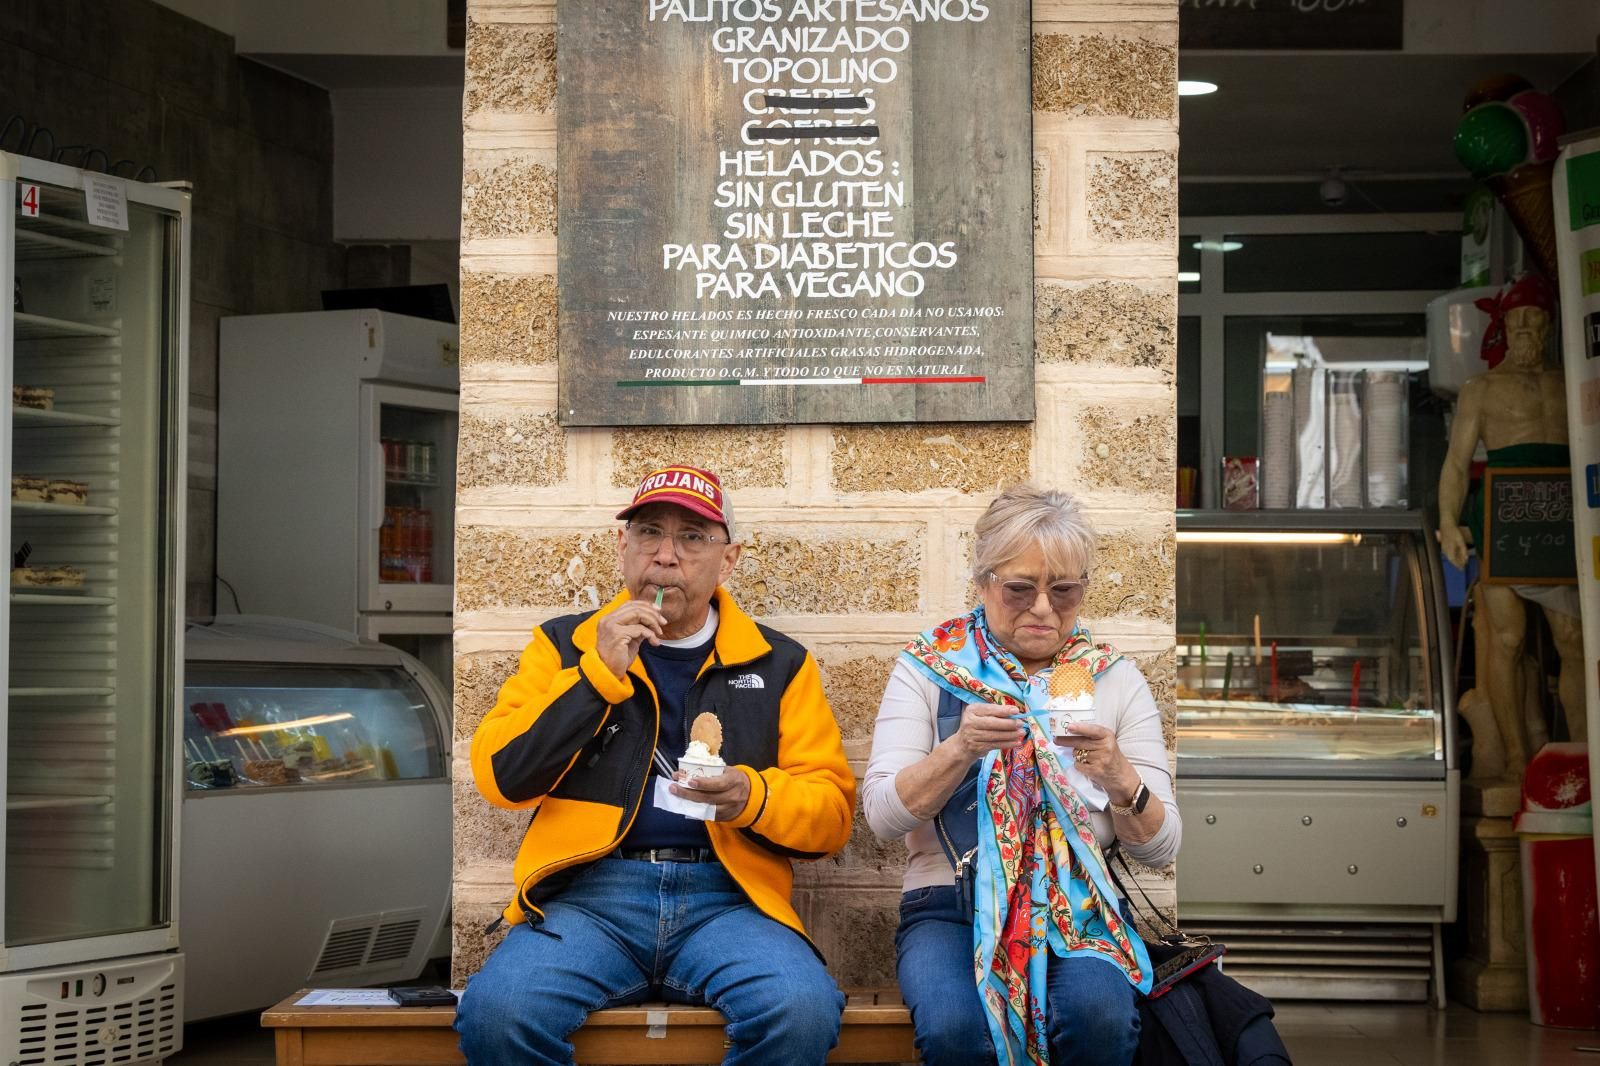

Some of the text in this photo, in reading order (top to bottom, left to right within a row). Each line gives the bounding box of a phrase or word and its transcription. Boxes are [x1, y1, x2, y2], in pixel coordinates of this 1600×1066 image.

[649, 0, 989, 22] PALITOS ARTESANOS
[712, 26, 910, 53] GRANIZADO
[723, 57, 898, 84] TOPOLINO
[719, 150, 884, 177] HELADOS
[23, 186, 38, 215] 4
[713, 181, 904, 208] SIN GLUTEN
[723, 211, 895, 239] SIN LECHE
[662, 241, 958, 271] PARA DIABETICOS
[695, 270, 925, 299] PARA VEGANO
[607, 310, 669, 321] NUESTRO
[671, 310, 733, 321] HELADOS
[736, 310, 752, 320] ES
[755, 309, 803, 320] HECHO
[806, 308, 858, 319] FRESCO
[861, 308, 896, 319] CADA
[899, 307, 924, 318] DIA
[925, 307, 944, 318] NO
[632, 329, 707, 340] ESPESANTE
[711, 328, 770, 342] QUIMICO
[629, 348, 734, 360] EDULCORANTES
[736, 347, 828, 359] ARTIFICIALES
[830, 346, 881, 358] GRASAS
[644, 364, 967, 378] PRODUCTO O.G.M. Y TODO LO QUE NO ES NATURAL
[637, 472, 715, 499] TROJANS
